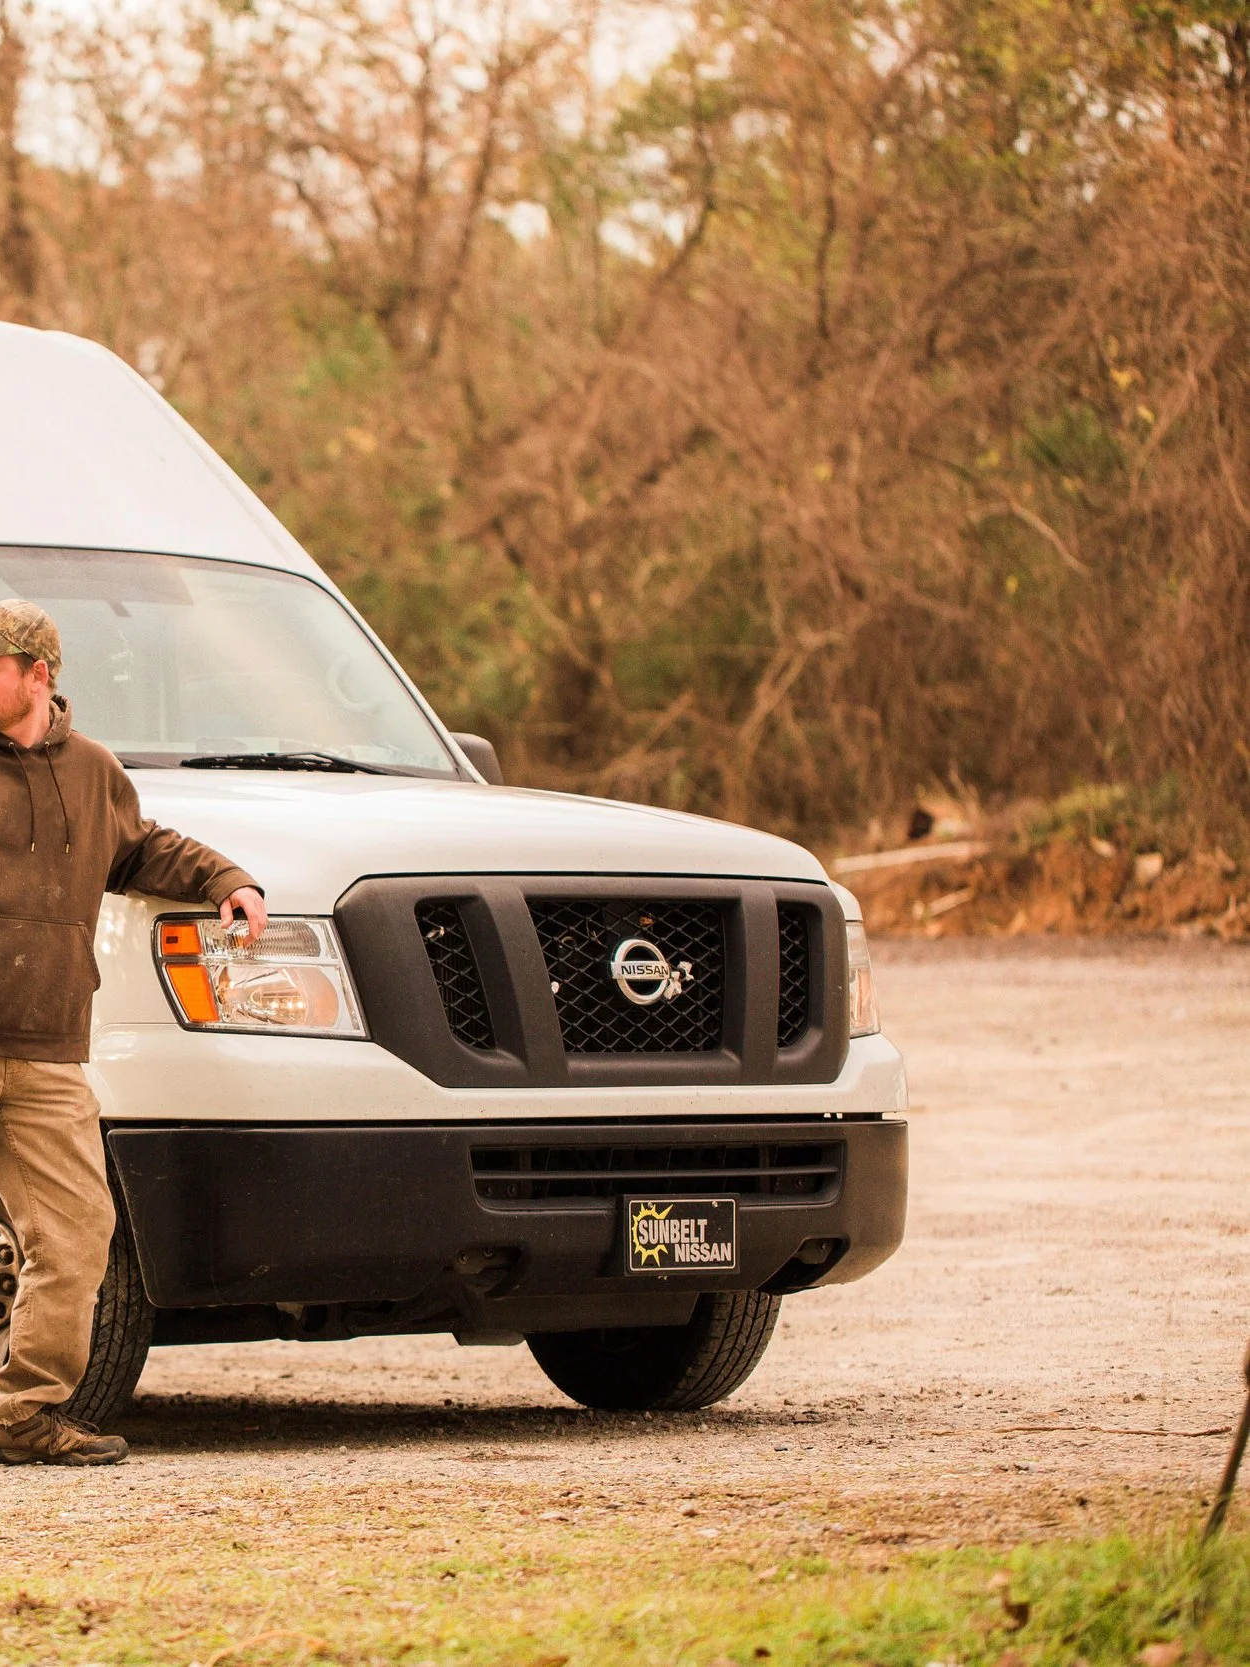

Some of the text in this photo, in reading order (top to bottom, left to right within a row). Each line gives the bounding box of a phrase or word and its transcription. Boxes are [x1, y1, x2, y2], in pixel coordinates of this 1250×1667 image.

[621, 965, 669, 976] NISSAN
[638, 1218, 708, 1245] SUNBELT
[674, 1242, 732, 1263] NISSAN
